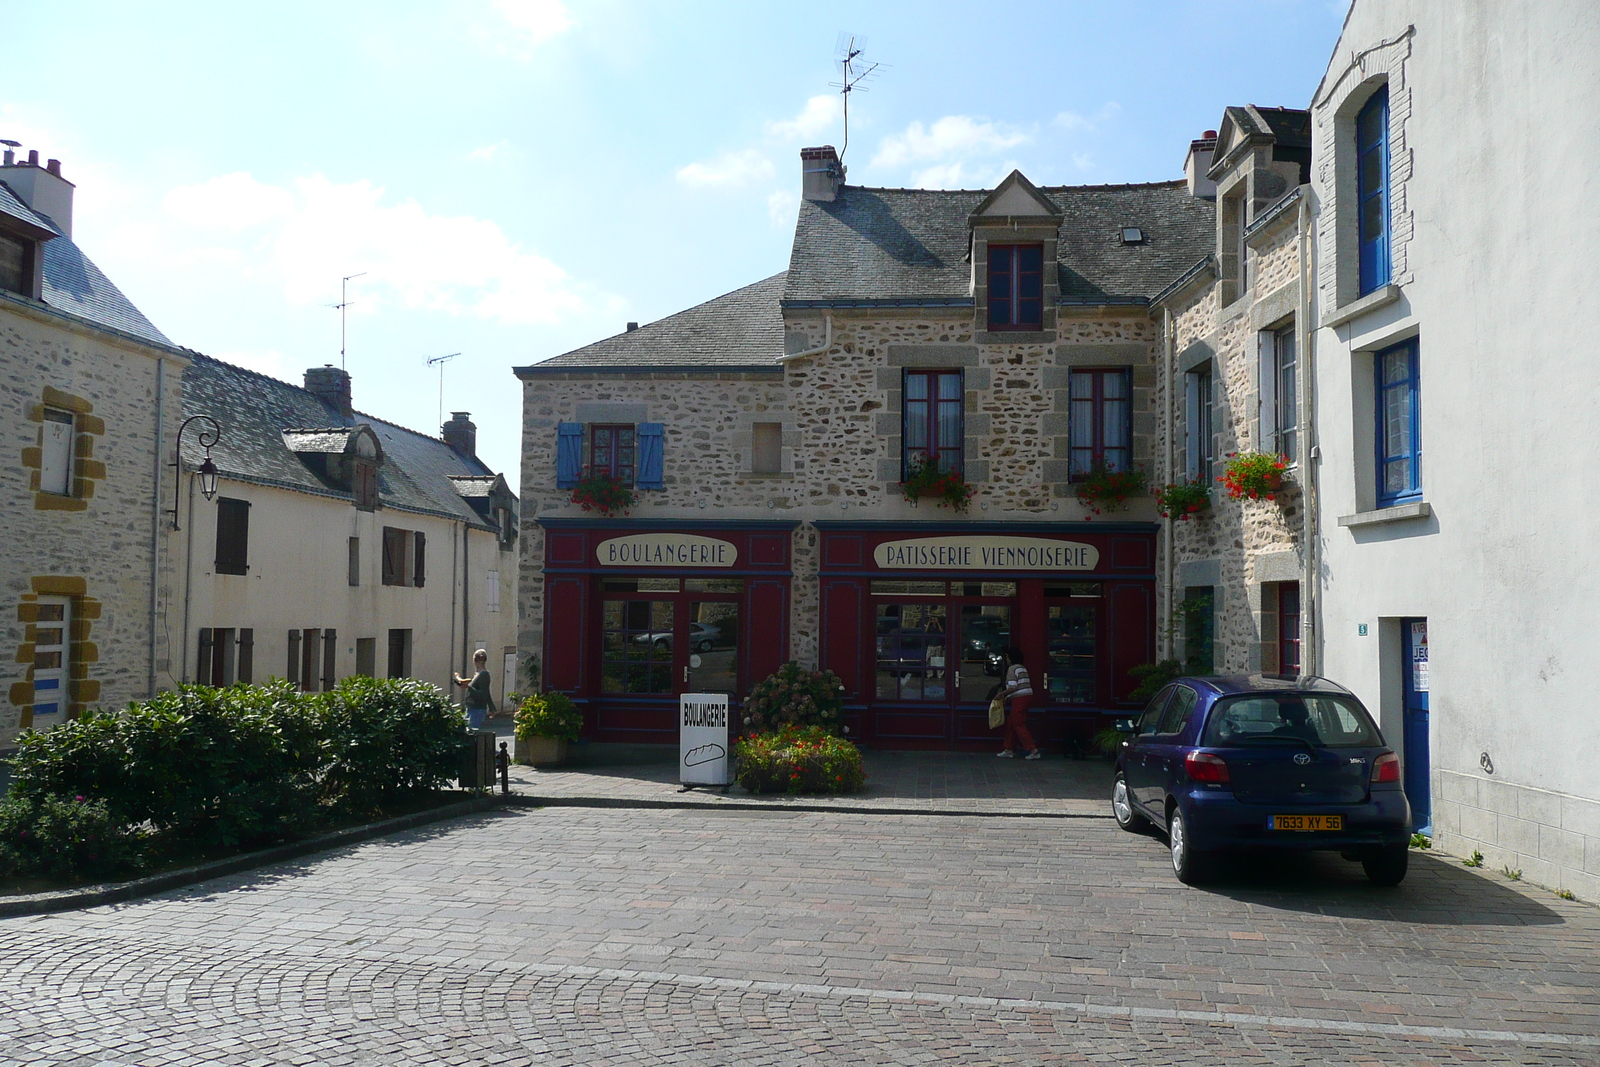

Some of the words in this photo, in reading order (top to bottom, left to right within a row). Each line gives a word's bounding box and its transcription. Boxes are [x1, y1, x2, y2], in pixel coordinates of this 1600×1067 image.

[609, 543, 725, 563] BOULANGERIE
[887, 546, 971, 566] PATISSERIE
[982, 546, 1088, 567] VIENNOISERIE
[684, 703, 725, 727] BOULANGERIE
[1276, 816, 1303, 829] 7633
[1308, 816, 1321, 829] XY
[1326, 816, 1339, 829] 56
